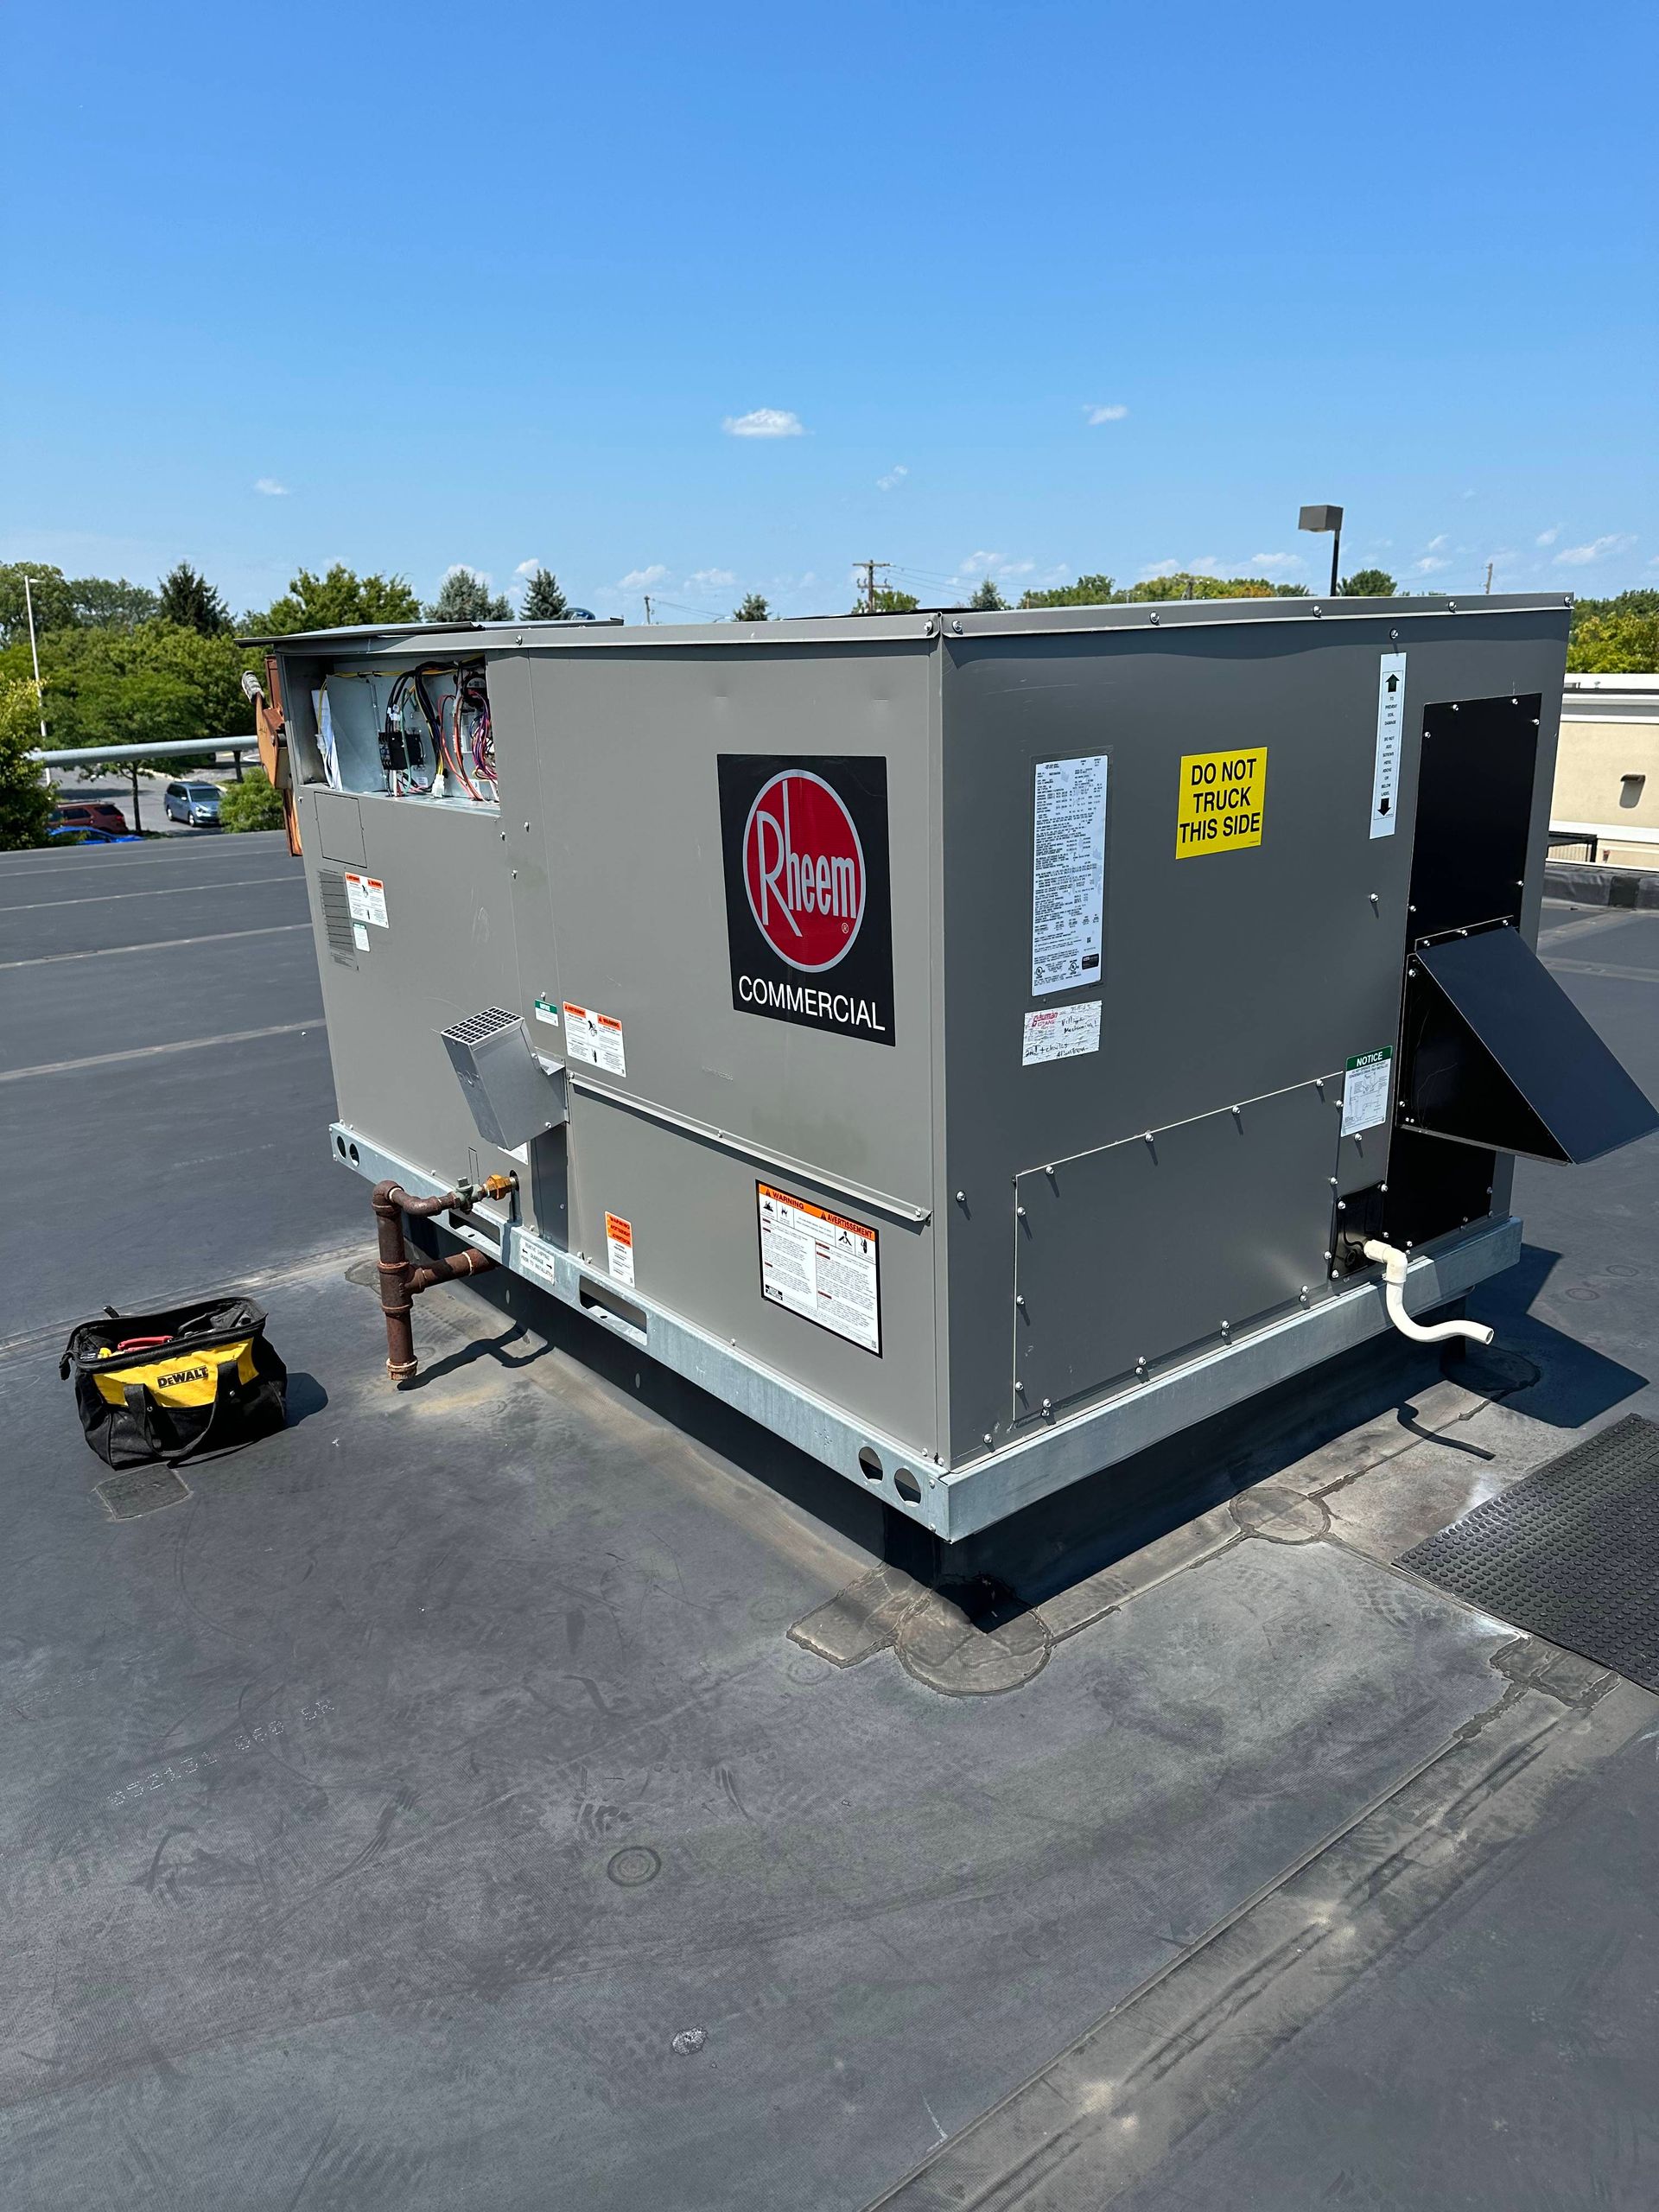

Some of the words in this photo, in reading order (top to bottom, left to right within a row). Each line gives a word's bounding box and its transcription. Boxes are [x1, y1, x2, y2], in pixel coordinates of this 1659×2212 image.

[1192, 763, 1217, 785] DO
[1222, 758, 1256, 782] NOT
[1193, 786, 1251, 813] TRUCK
[1179, 818, 1217, 843] THIS
[1223, 812, 1261, 837] SIDE
[756, 780, 856, 937] Rheem
[739, 975, 886, 1031] COMMERCIAL
[1357, 1052, 1382, 1067] NOTICE
[772, 1191, 804, 1210] WARNING
[828, 1213, 873, 1239] AVERTISSEMENT
